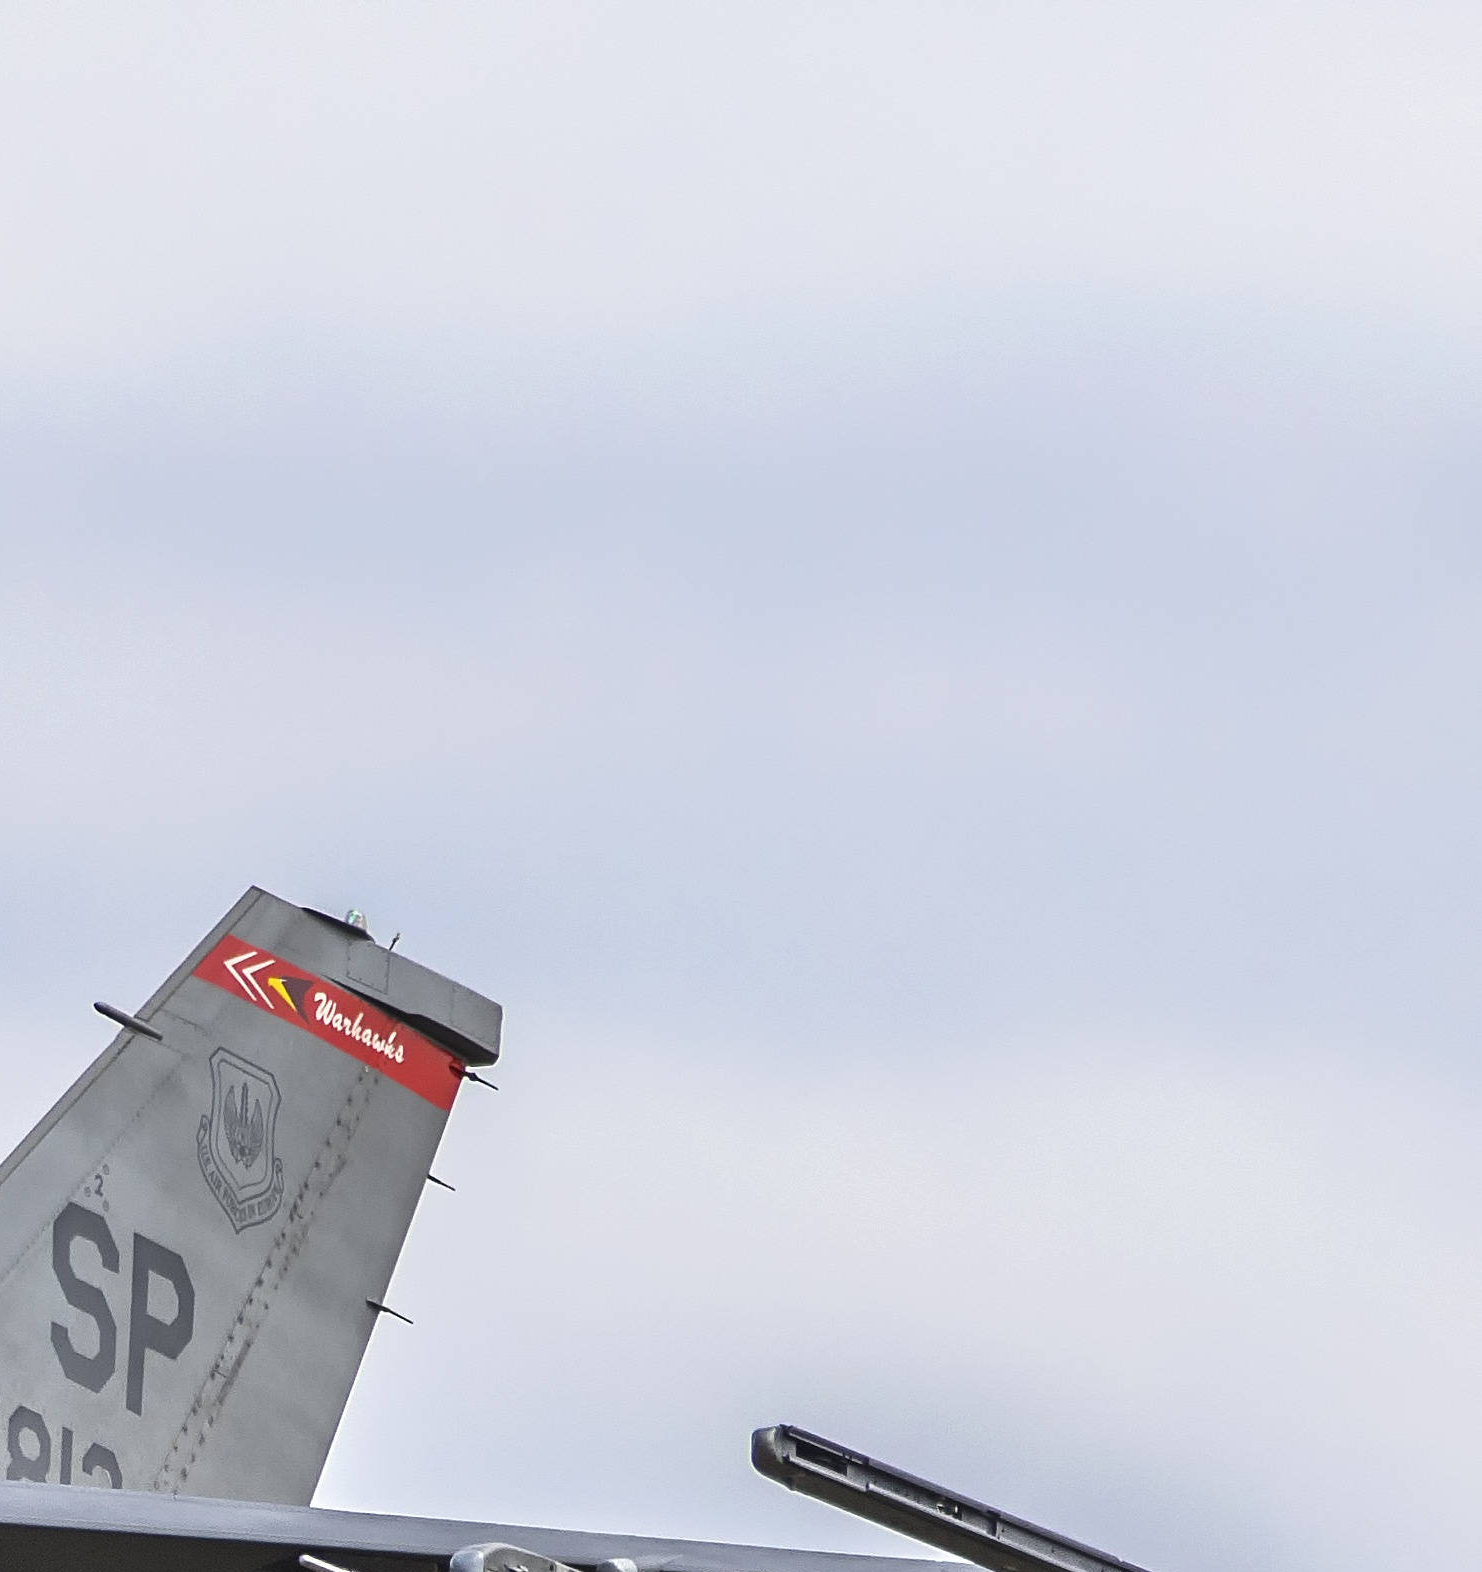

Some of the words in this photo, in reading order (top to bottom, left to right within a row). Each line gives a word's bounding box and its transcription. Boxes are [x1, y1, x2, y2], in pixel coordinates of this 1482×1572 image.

[313, 991, 404, 1064] Warhawks
[94, 1173, 104, 1197] 2
[50, 1201, 195, 1418] SP
